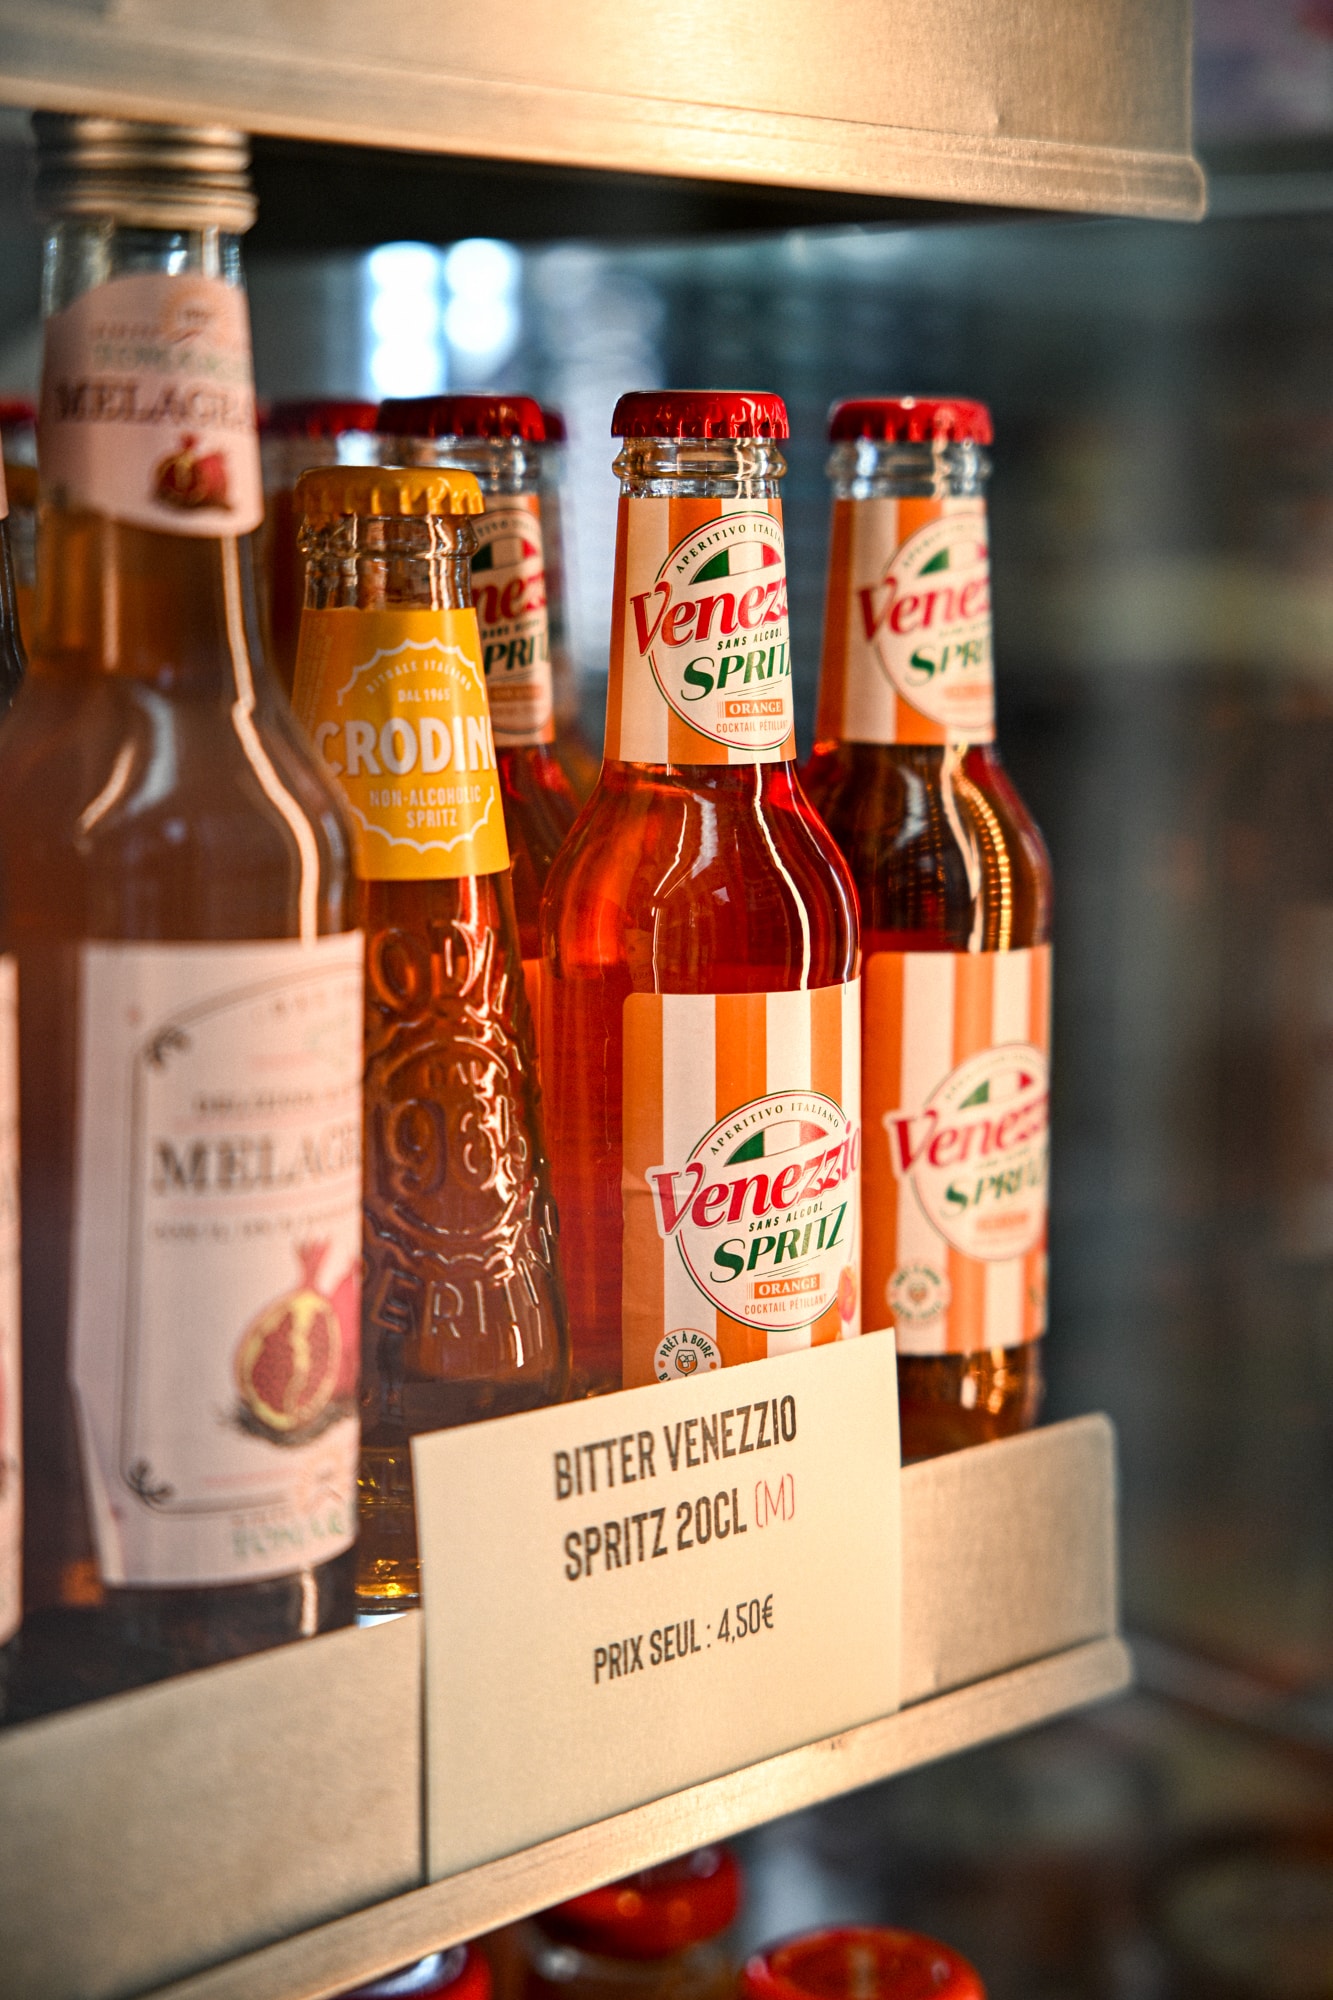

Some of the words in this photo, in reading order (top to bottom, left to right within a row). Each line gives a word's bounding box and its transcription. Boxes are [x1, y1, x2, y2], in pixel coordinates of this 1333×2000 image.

[676, 524, 747, 573] APERITIVO
[717, 636, 747, 651] SANS
[753, 628, 782, 643] ALCOOL
[729, 701, 781, 715] ORANGE
[716, 721, 756, 733] COCKTAIL
[370, 785, 481, 808] NON-ALCOHOLIC
[406, 808, 458, 828] SPRITZ
[710, 1104, 784, 1156] APERITIVO
[791, 1102, 840, 1128] ITALIANO
[651, 1121, 861, 1235] Venezzio
[749, 1216, 780, 1232] SANS
[786, 1201, 823, 1223] ALCOOL
[710, 1200, 848, 1283] SPRITZ
[758, 1276, 818, 1296] ORANGE
[744, 1301, 786, 1315] COCKTAIL
[790, 1293, 828, 1311] PÉTILLANT
[660, 1335, 679, 1357] PRÊT
[682, 1330, 688, 1343] À
[690, 1334, 714, 1358] BOIRE
[554, 1430, 656, 1501] BITTER
[663, 1394, 797, 1472] VENEZZIO
[564, 1507, 668, 1582] SPRITZ
[676, 1487, 747, 1551] 20CL
[755, 1473, 795, 1528] (M)
[593, 1635, 644, 1684] PRIX
[650, 1619, 701, 1666] SEUL
[717, 1593, 774, 1644] 4,50€
